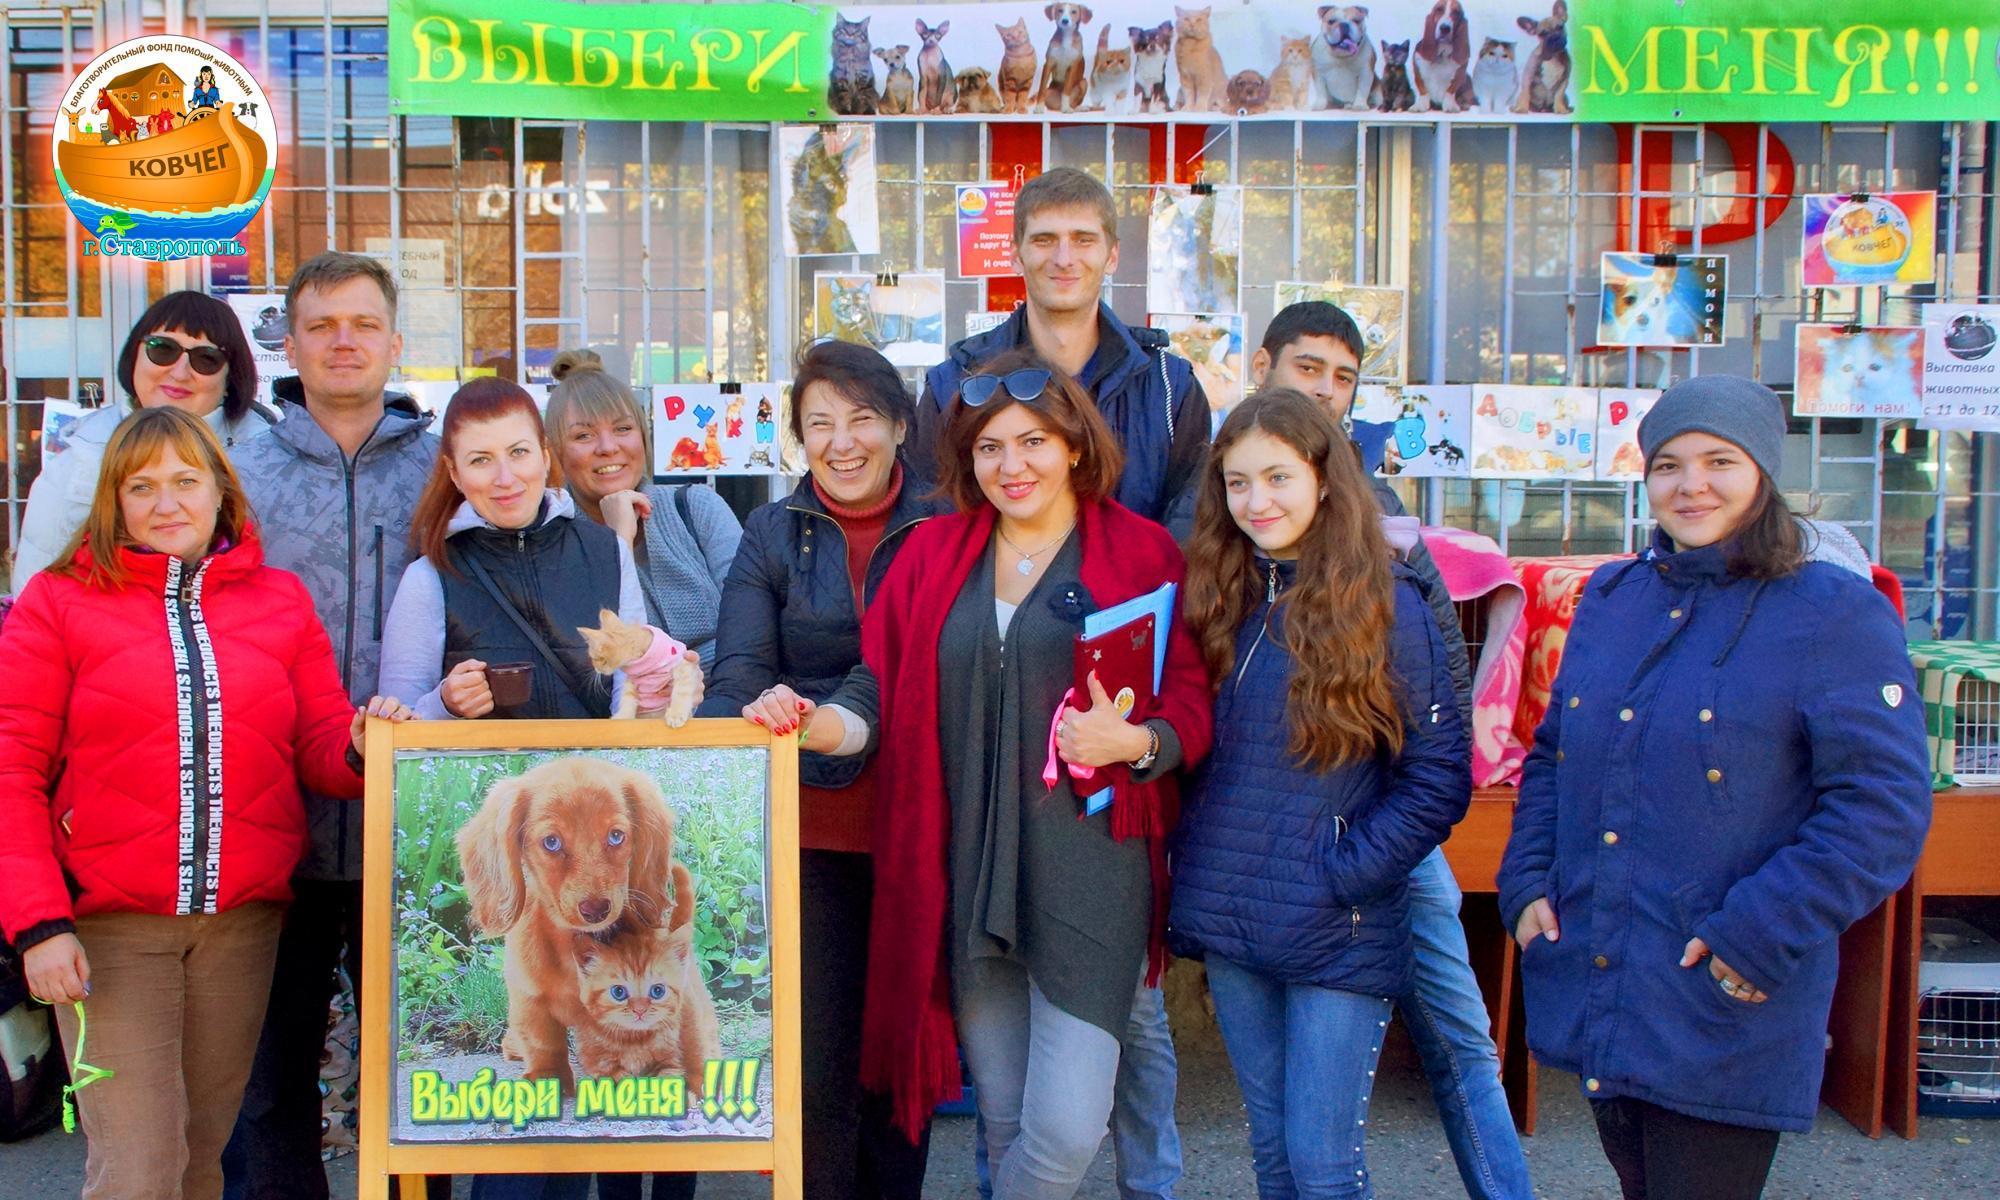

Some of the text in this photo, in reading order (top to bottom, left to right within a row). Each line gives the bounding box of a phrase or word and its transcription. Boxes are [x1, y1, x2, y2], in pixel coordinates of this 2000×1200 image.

[408, 15, 810, 94] ВЫБЕРИ
[1925, 361, 1995, 373] Выставка
[1924, 384, 2000, 395] животных
[1937, 404, 1952, 416] 11
[1959, 404, 1975, 416] до
[412, 1067, 562, 1130] Выбери
[574, 1076, 688, 1123] меня
